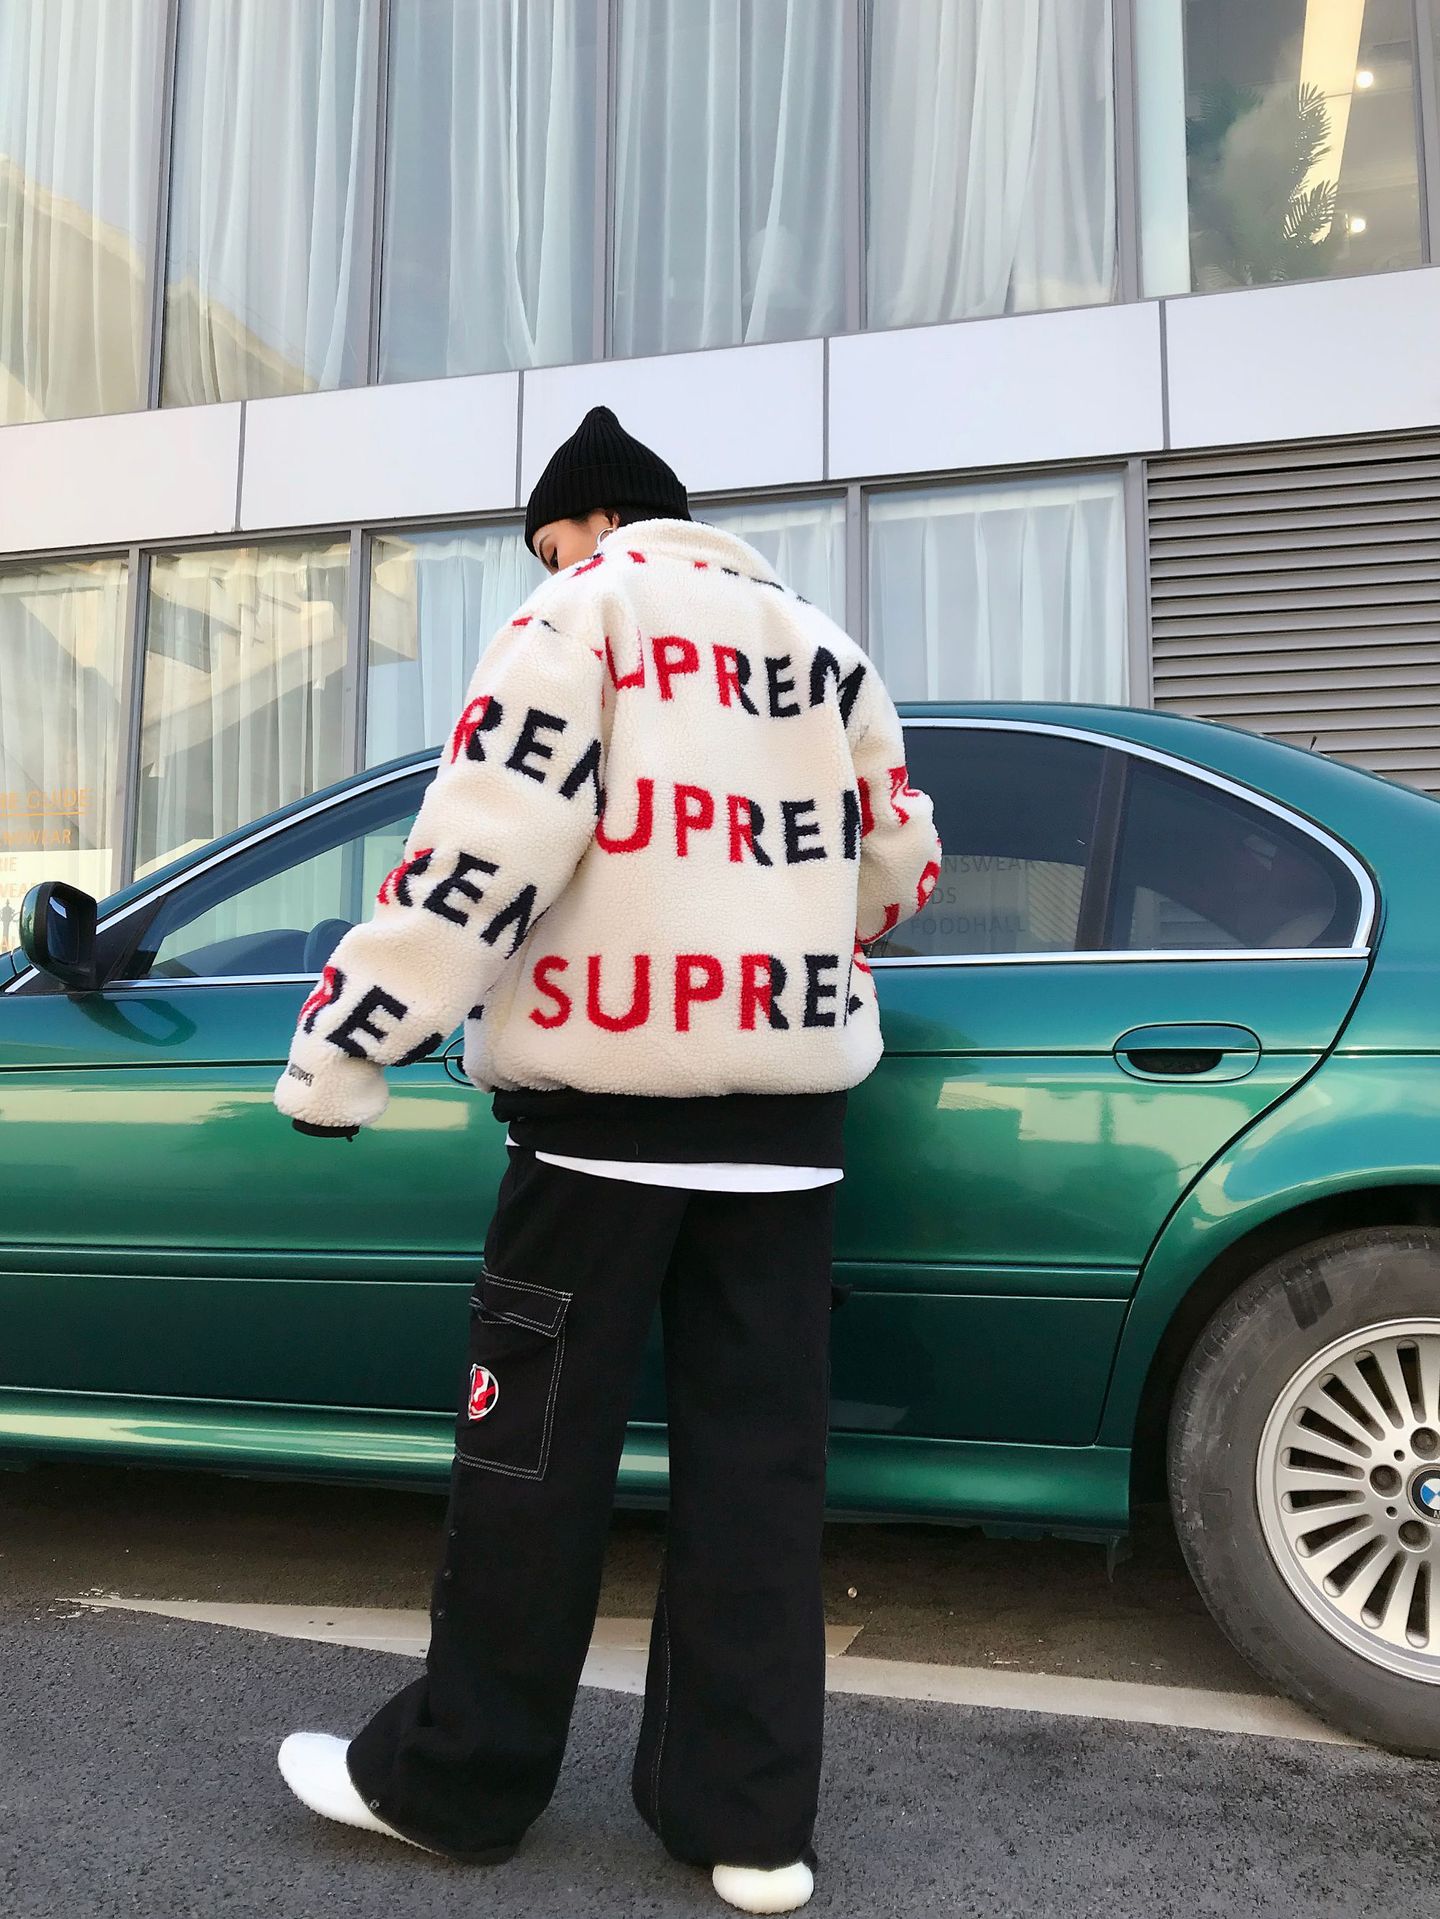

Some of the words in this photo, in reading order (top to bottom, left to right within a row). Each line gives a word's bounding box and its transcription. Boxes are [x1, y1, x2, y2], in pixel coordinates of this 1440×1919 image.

[592, 627, 866, 730] UPREM
[910, 914, 1026, 935] FOODHALL
[528, 951, 864, 1034] SUPRE
